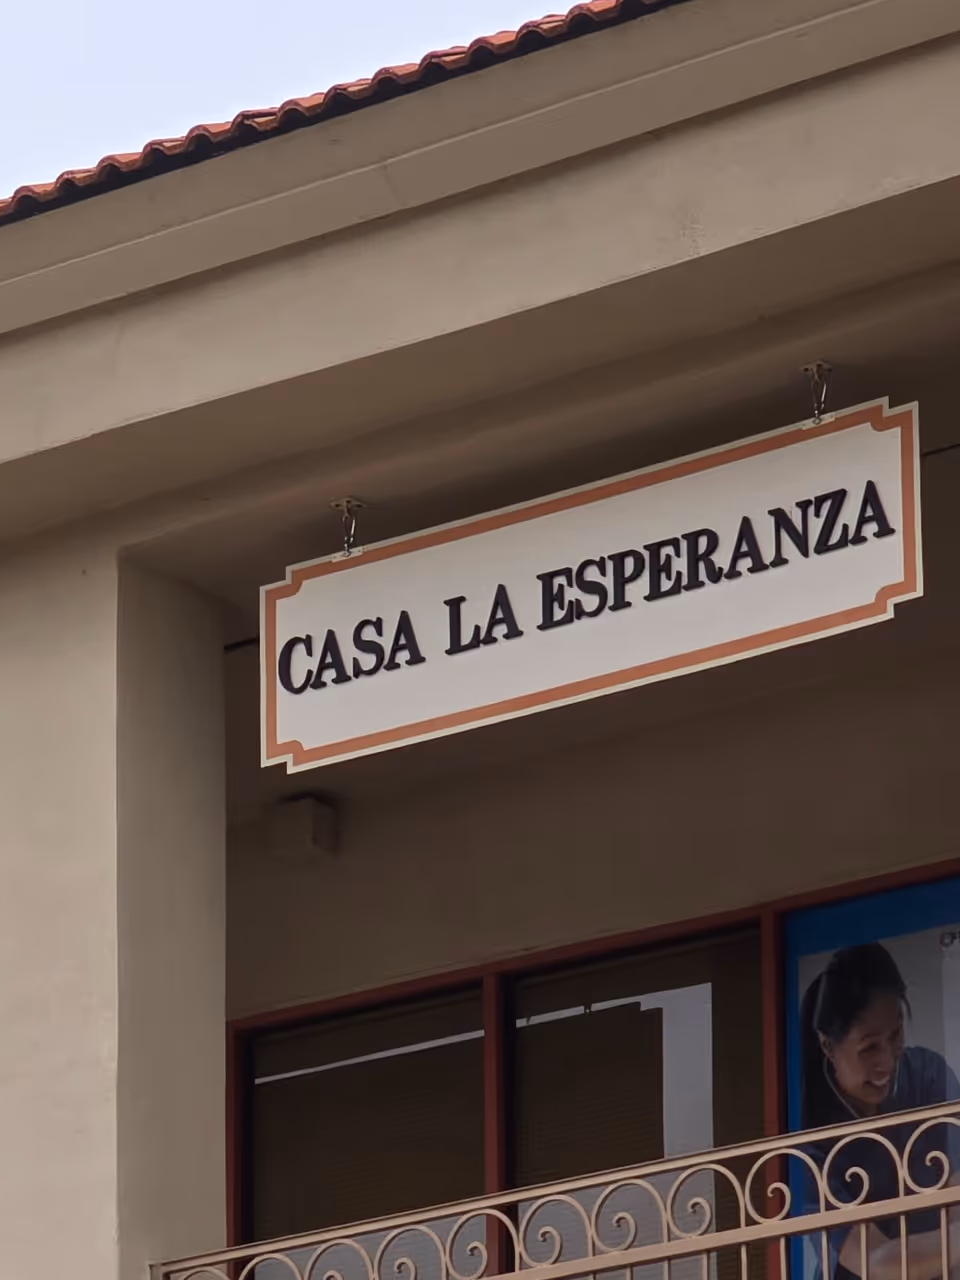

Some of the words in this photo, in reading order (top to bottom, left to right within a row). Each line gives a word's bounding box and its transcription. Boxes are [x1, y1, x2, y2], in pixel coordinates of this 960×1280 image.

[278, 608, 426, 694] CASA
[443, 583, 523, 655] LA
[536, 478, 896, 631] ESPERANZA
